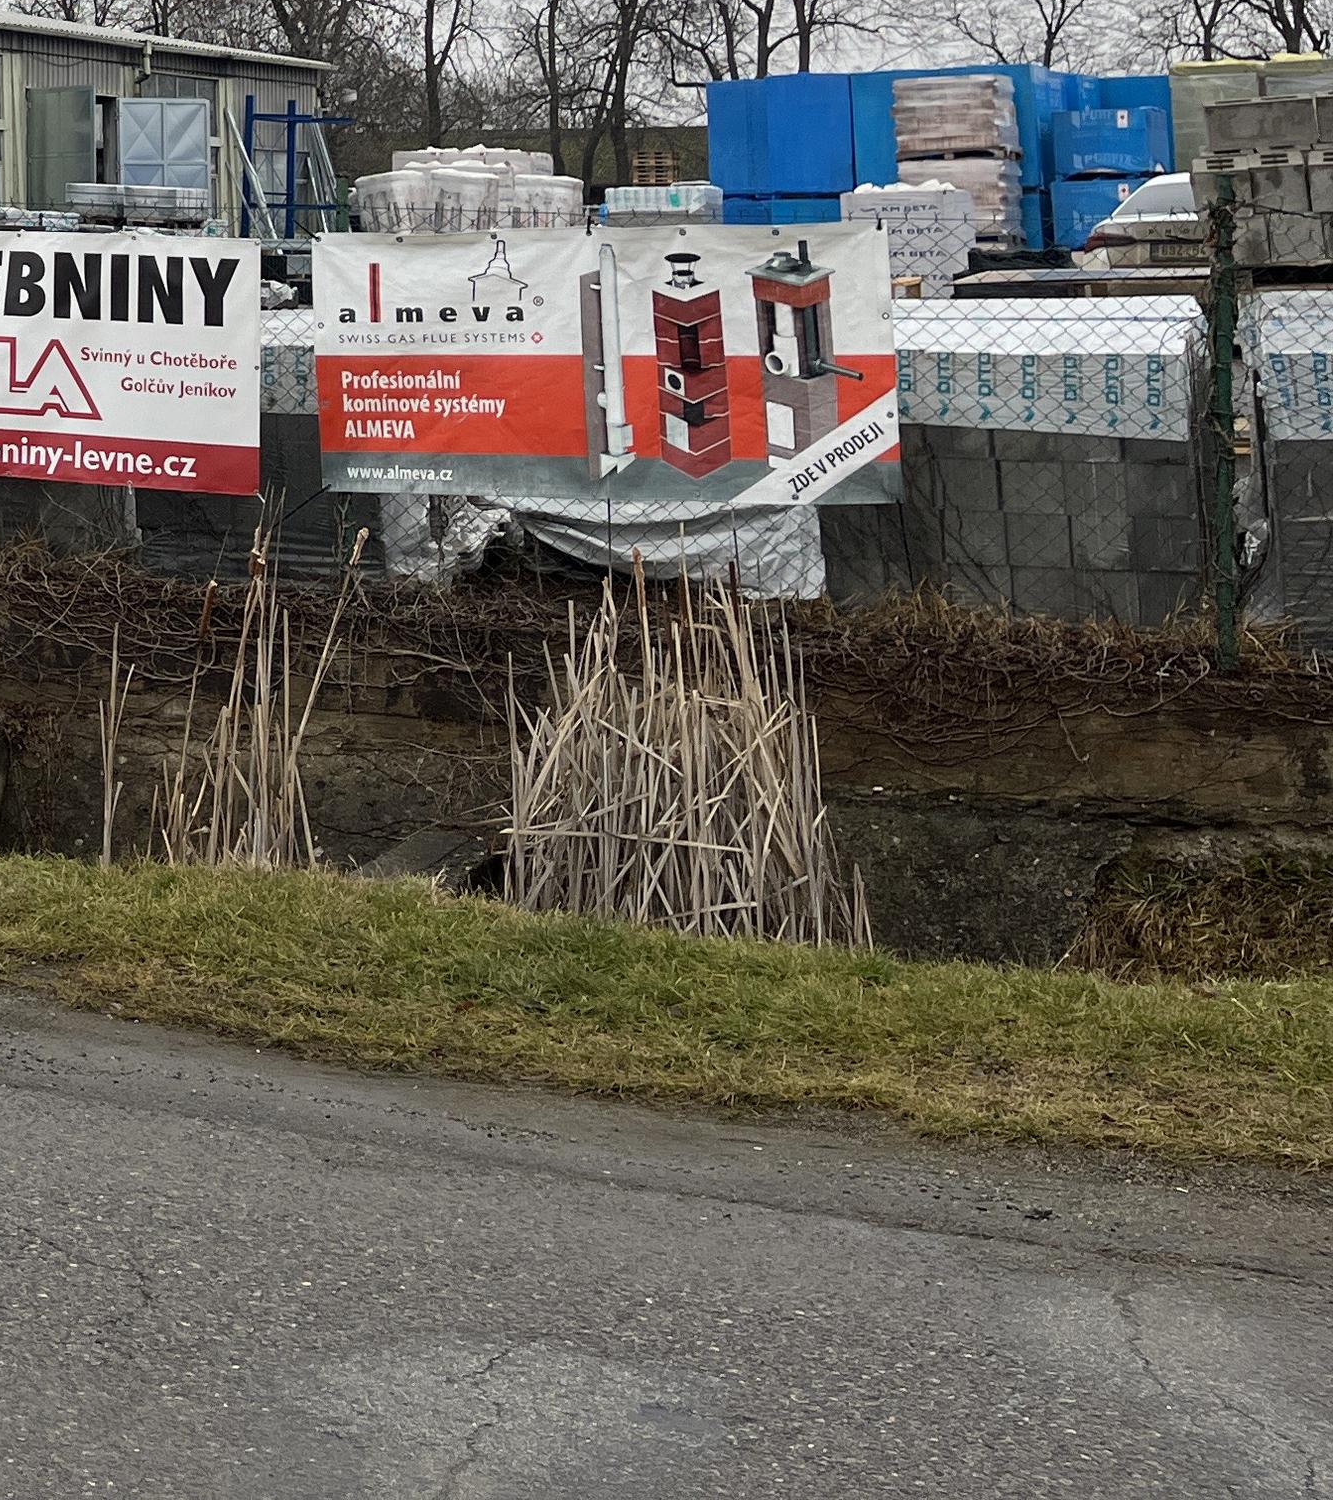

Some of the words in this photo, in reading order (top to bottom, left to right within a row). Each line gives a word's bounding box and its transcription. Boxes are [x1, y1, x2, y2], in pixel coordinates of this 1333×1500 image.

[339, 263, 525, 323] almeva
[339, 333, 381, 344] SWISS
[387, 334, 415, 344] GAS
[423, 333, 457, 344] FLUE
[465, 332, 526, 344] SYSTEMS
[80, 347, 132, 367] Svinný
[137, 355, 145, 365] u
[150, 351, 237, 371] Chotěboře
[121, 376, 174, 395] Golčův
[178, 380, 237, 398] Jeníkov
[341, 370, 461, 389] Profesionální
[343, 393, 430, 412] komínové
[434, 394, 505, 418] systémy
[344, 419, 415, 439] ALMEVA
[787, 467, 819, 493] ZDE
[813, 459, 827, 474] V
[825, 422, 885, 467] PRODEJI
[347, 465, 453, 481] www.almeva.cz
